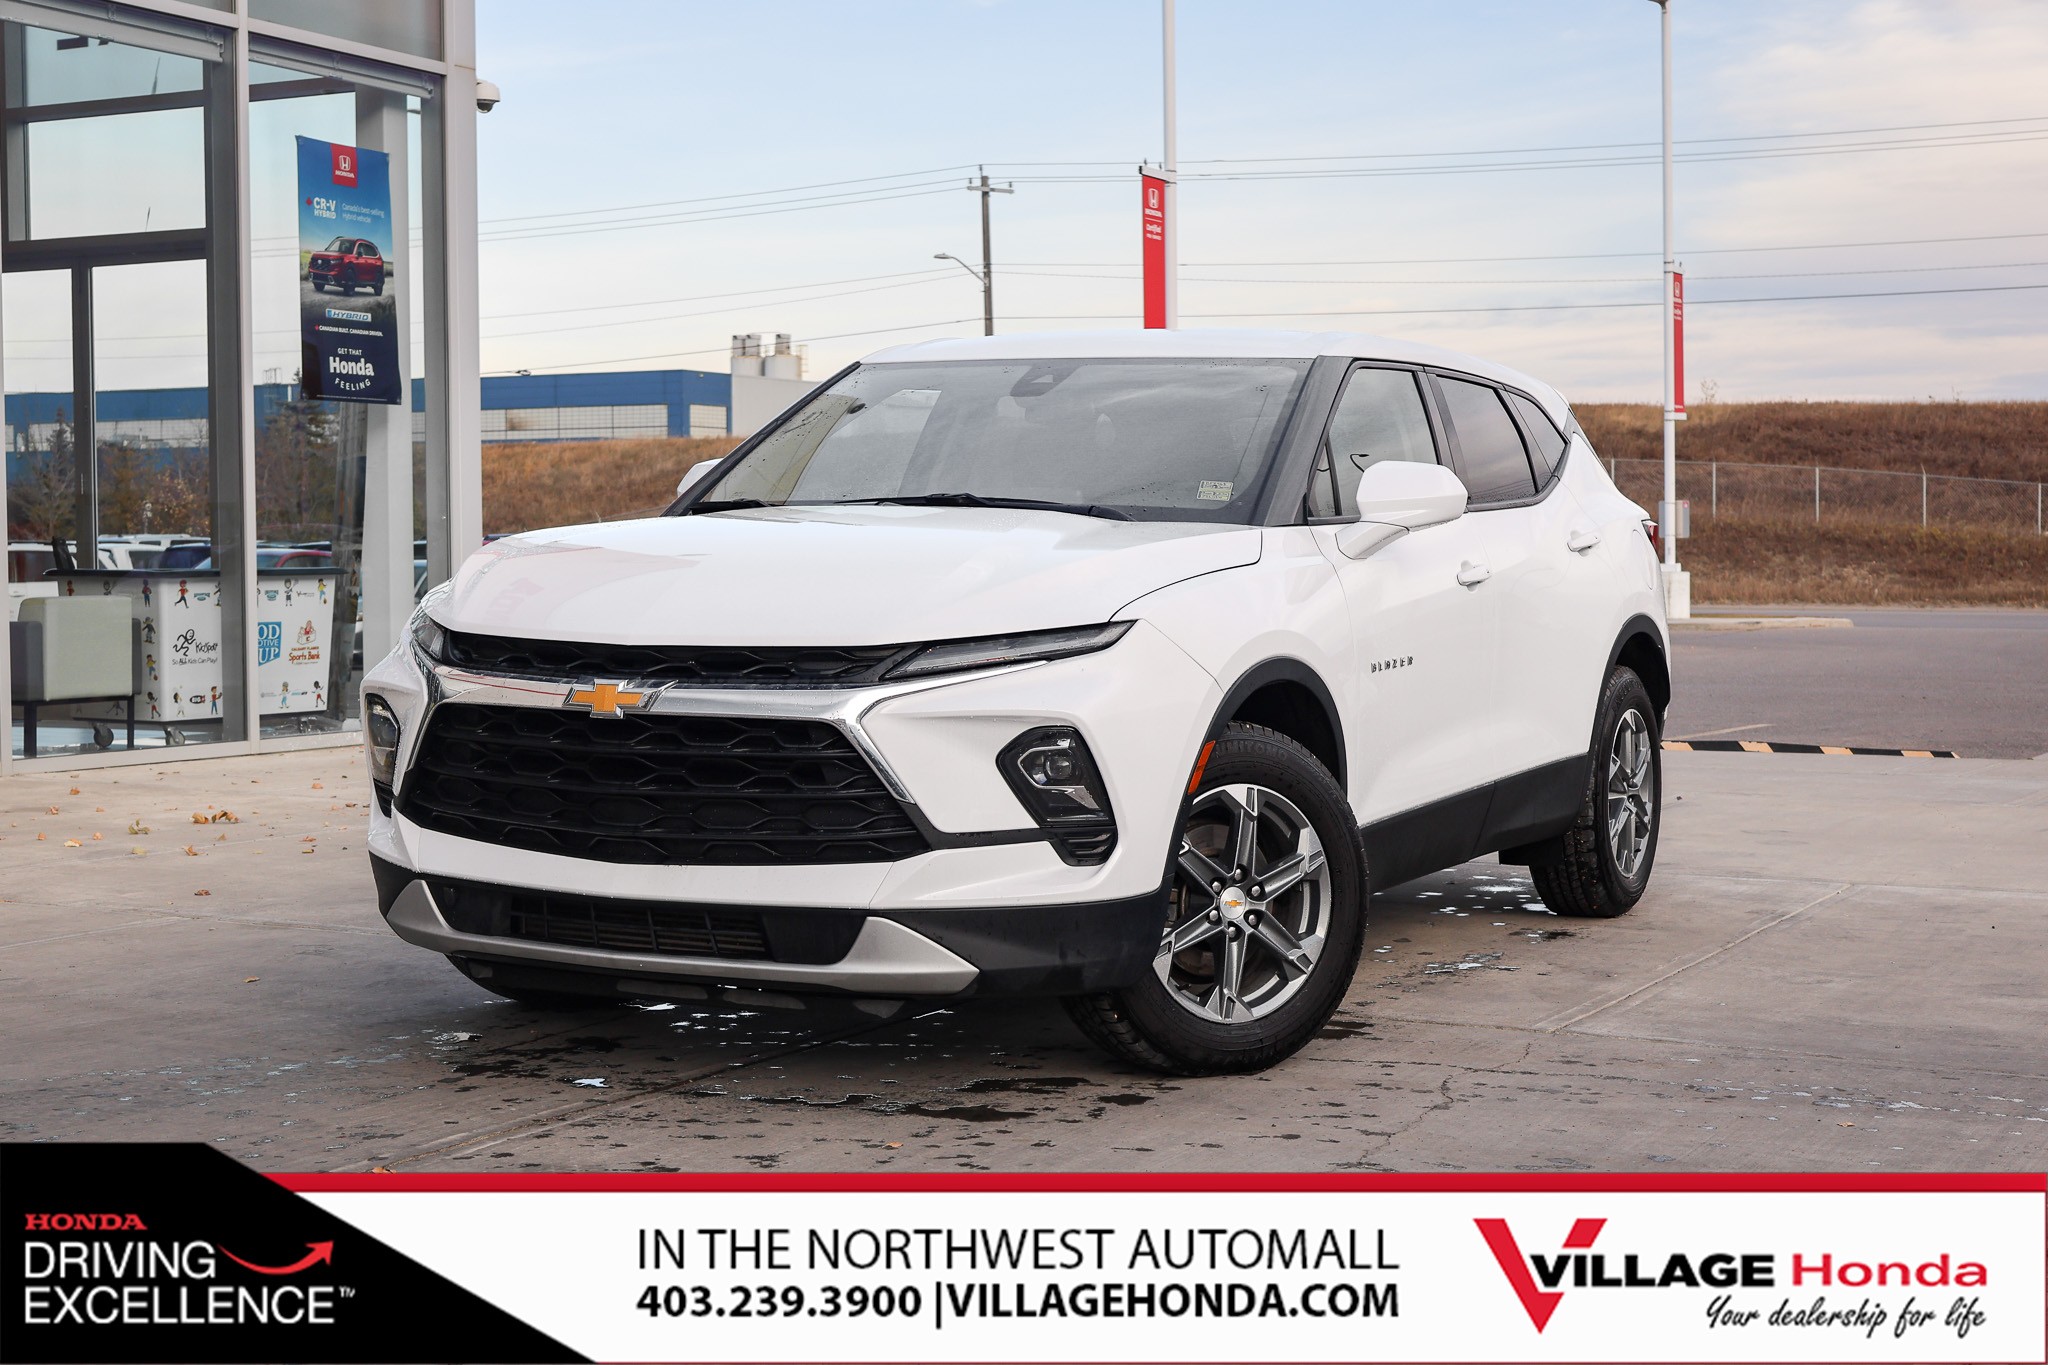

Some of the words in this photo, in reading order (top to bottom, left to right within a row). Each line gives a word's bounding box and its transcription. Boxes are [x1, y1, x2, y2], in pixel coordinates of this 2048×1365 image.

[313, 197, 336, 211] CR-V
[314, 208, 337, 219] HYBRID
[348, 348, 362, 356] THAT
[329, 356, 375, 376] Honda
[334, 377, 371, 391] FEELING
[288, 652, 307, 664] Sports
[1371, 656, 1414, 674] BLAZER
